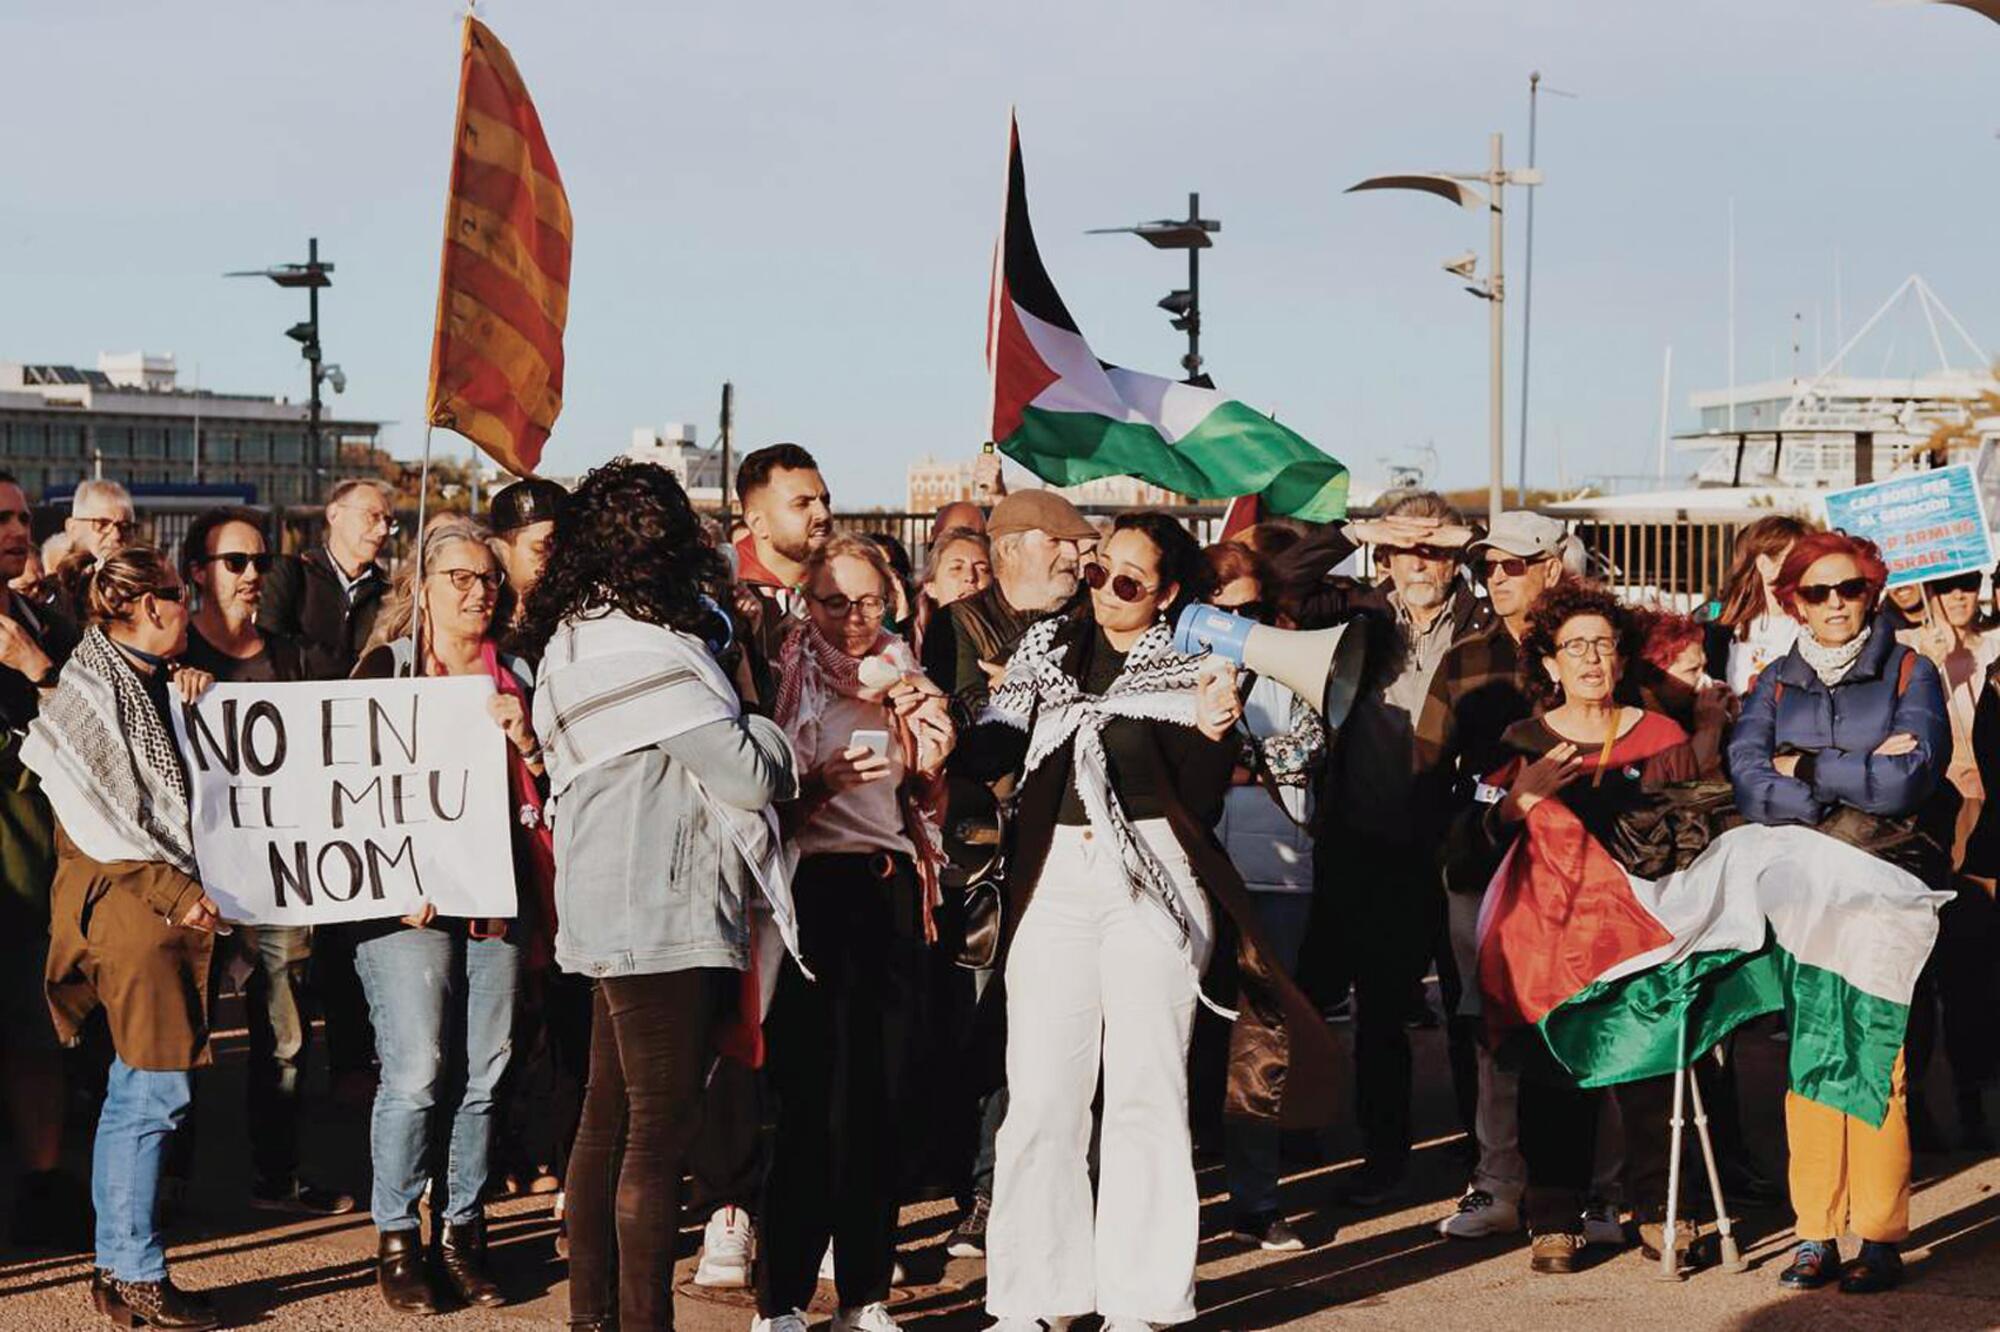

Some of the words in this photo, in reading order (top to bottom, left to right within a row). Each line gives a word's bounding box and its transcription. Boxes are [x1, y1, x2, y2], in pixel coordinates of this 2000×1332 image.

[182, 699, 287, 776] NO
[322, 694, 418, 766] EN
[229, 785, 299, 829] EL
[332, 769, 468, 829] MEU
[268, 836, 424, 907] NOM
